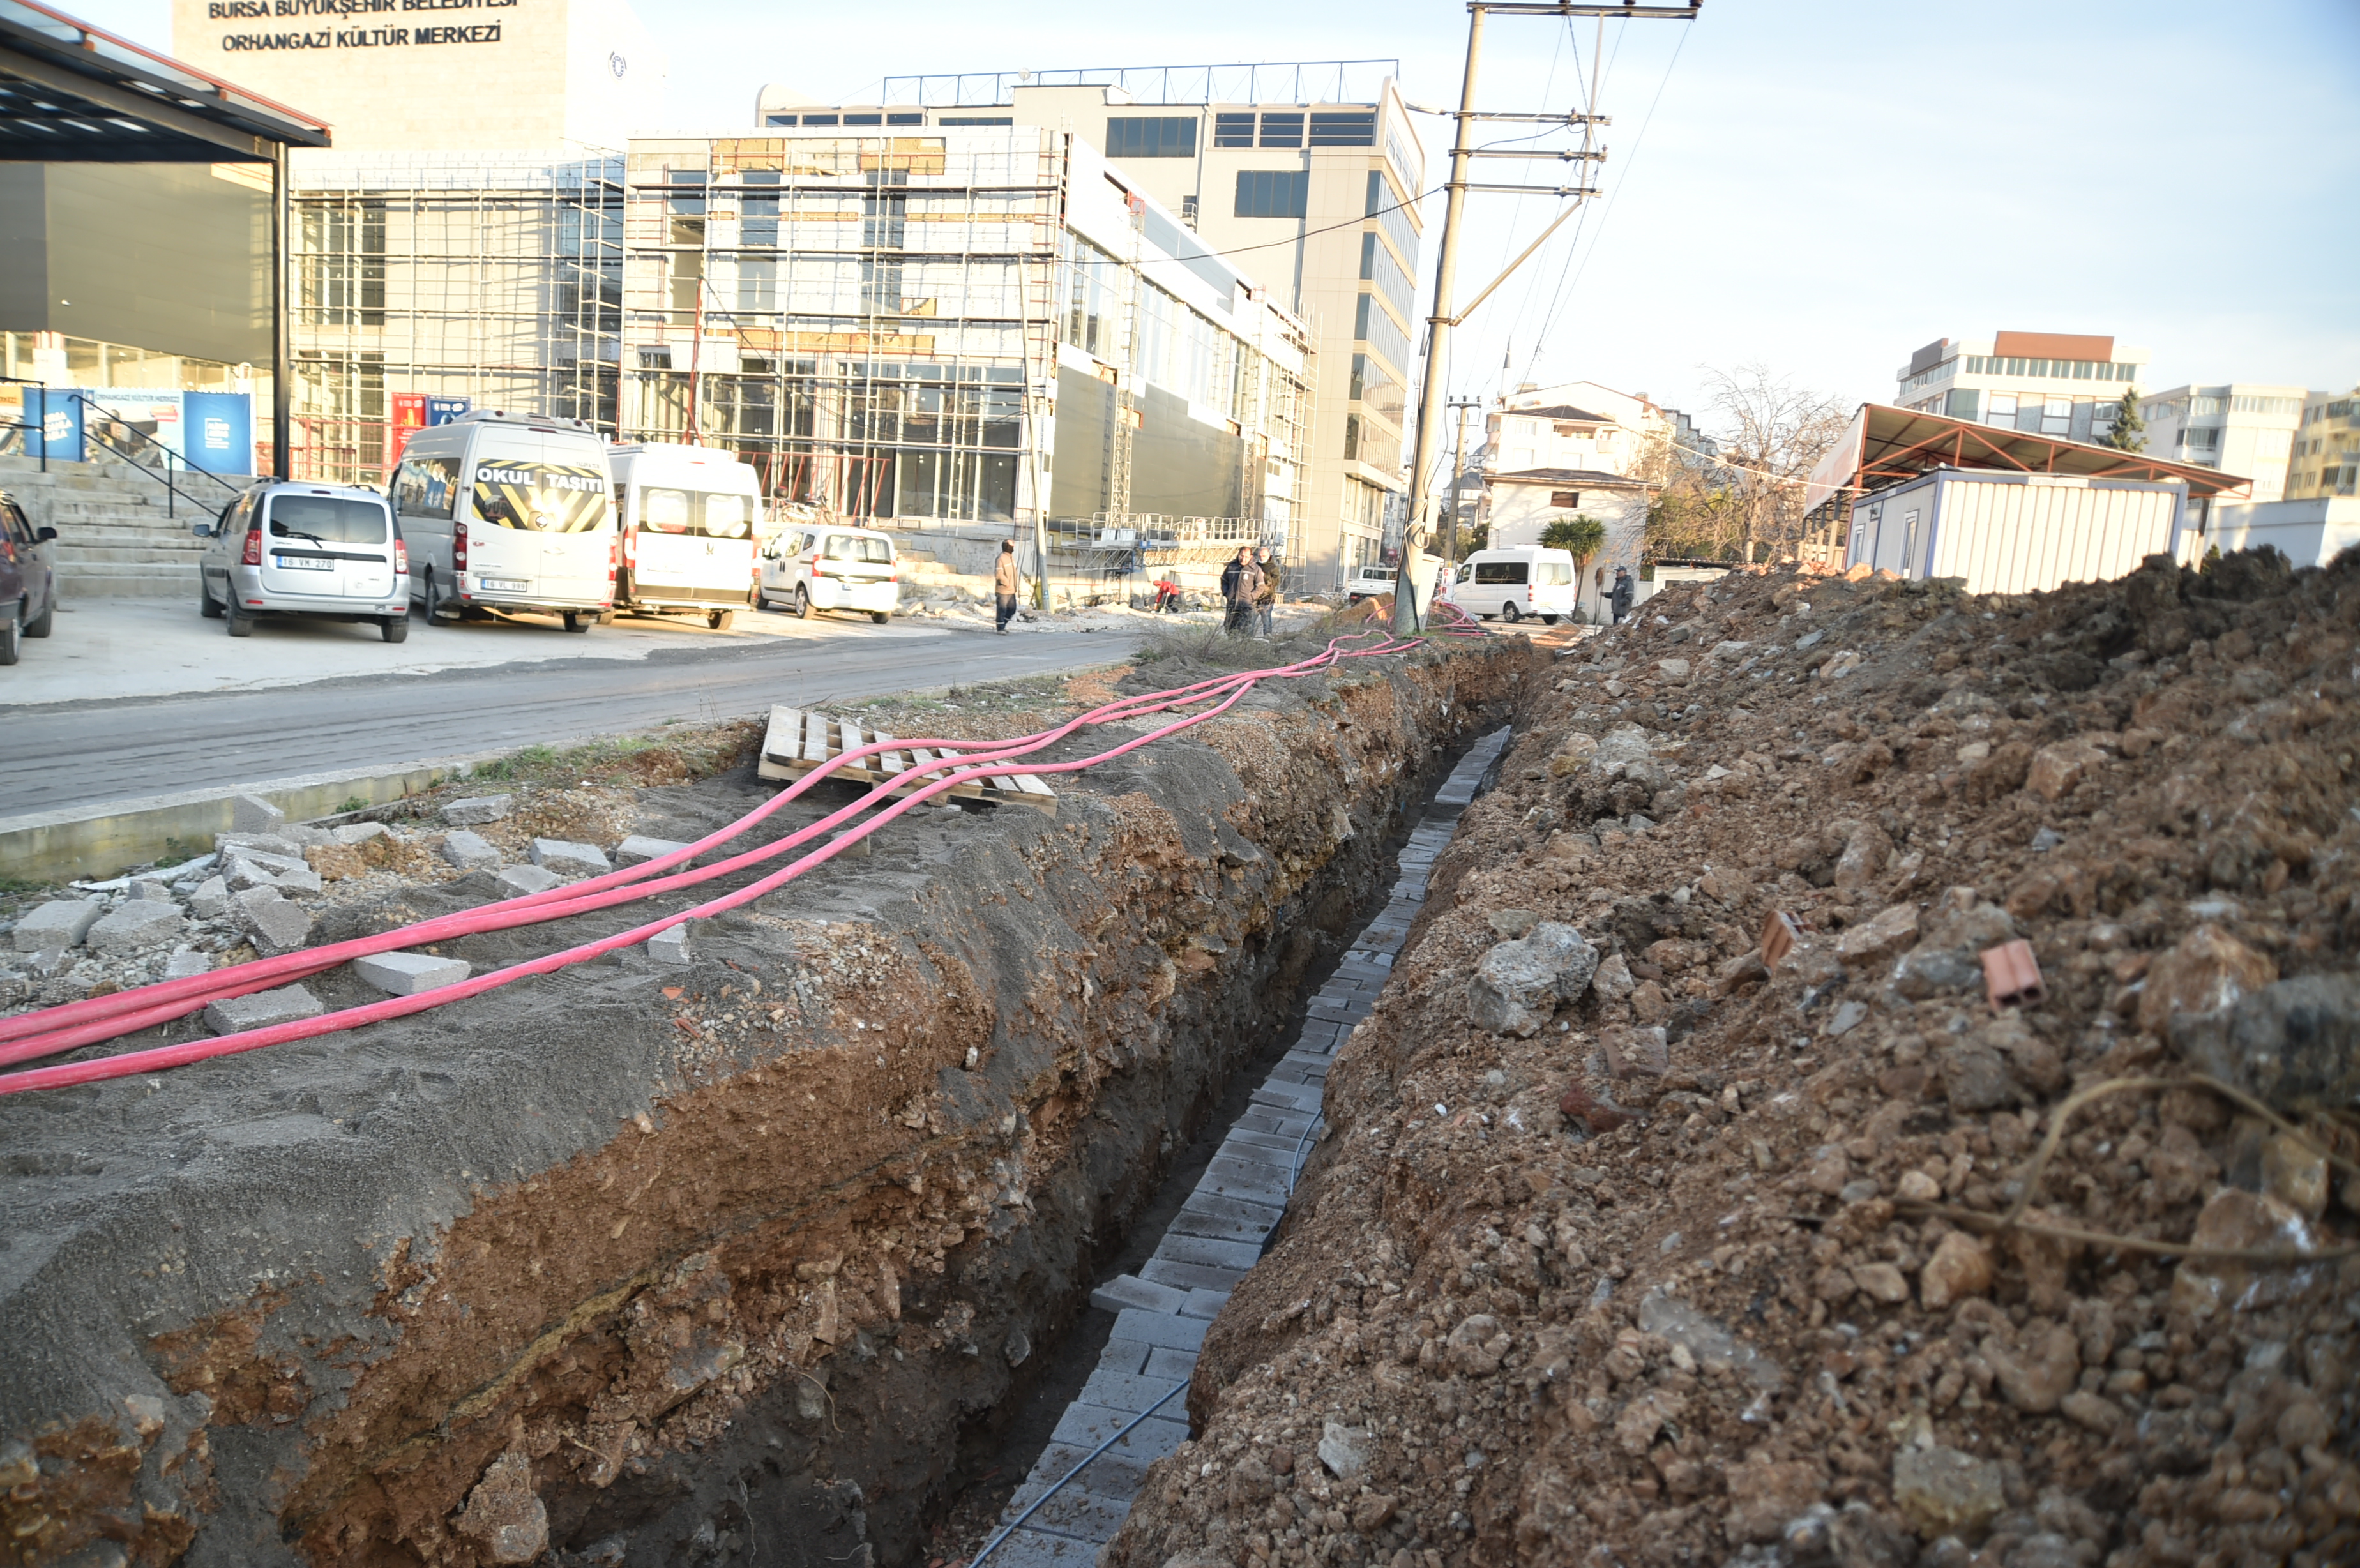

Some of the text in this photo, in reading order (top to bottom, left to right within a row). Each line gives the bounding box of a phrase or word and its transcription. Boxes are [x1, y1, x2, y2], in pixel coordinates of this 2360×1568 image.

[208, 1, 271, 19] BURSA
[402, 0, 518, 11] BELED
[222, 19, 502, 51] ORHANGAZİ KÜLTÜR MERKEZİ
[477, 467, 535, 486] OKUL
[284, 557, 332, 569] 16 VM 270
